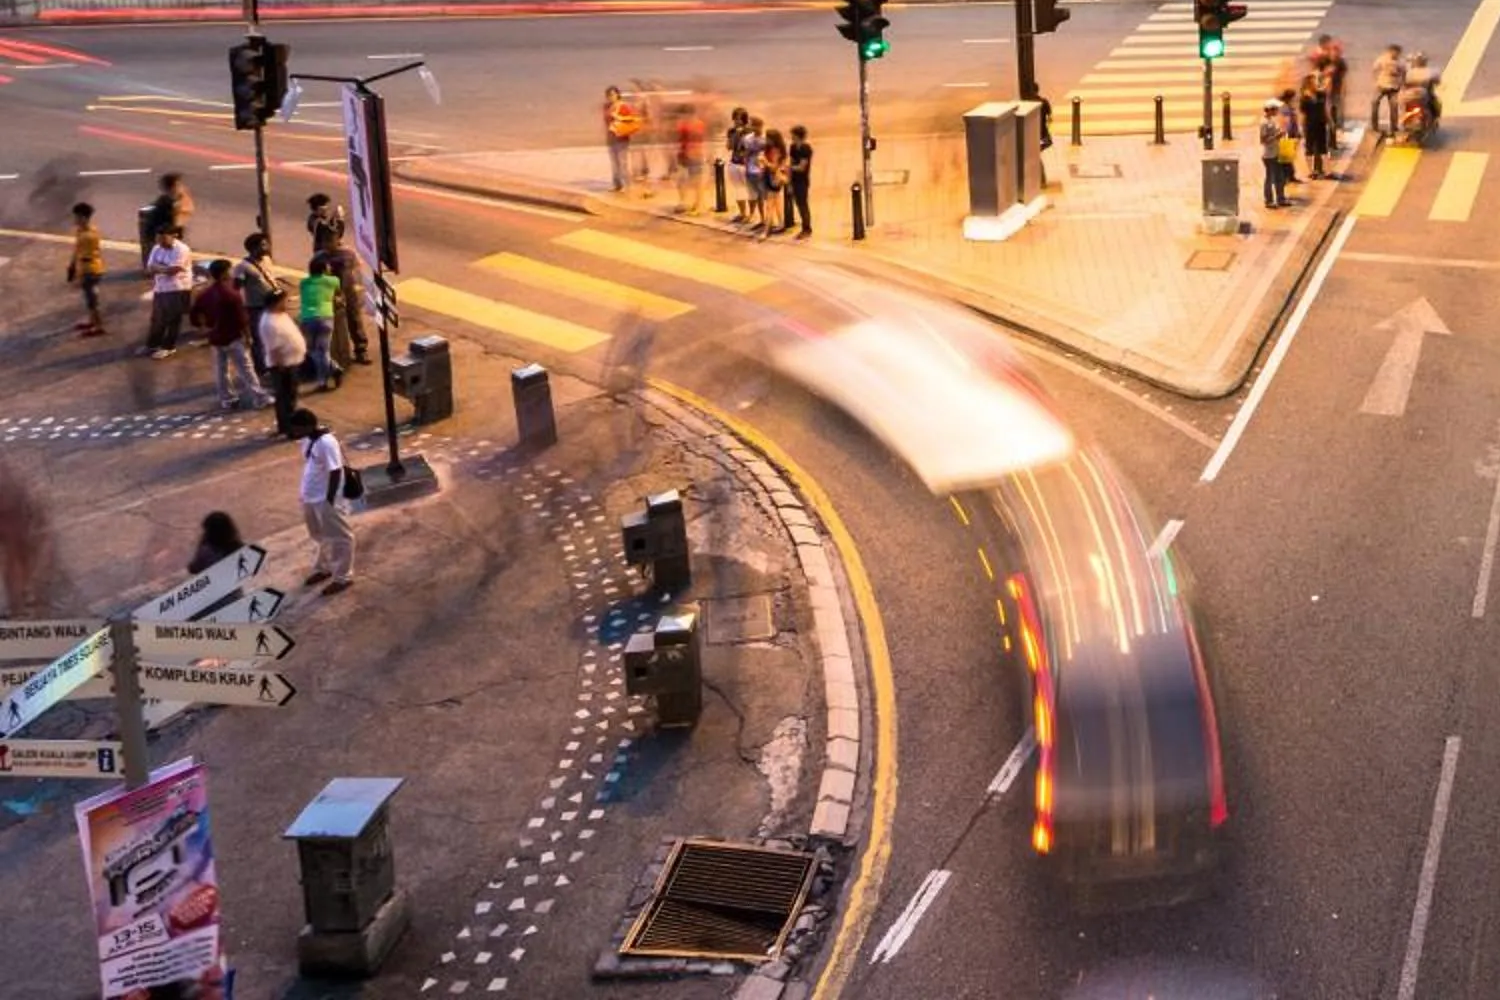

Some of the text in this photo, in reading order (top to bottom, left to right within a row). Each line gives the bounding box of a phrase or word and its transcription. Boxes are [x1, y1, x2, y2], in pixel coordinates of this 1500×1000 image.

[177, 575, 211, 601] ARABIA
[53, 624, 87, 638] WALK
[155, 625, 238, 641] BINTANG WALK
[145, 667, 255, 686] KOMPLEKS KRAF
